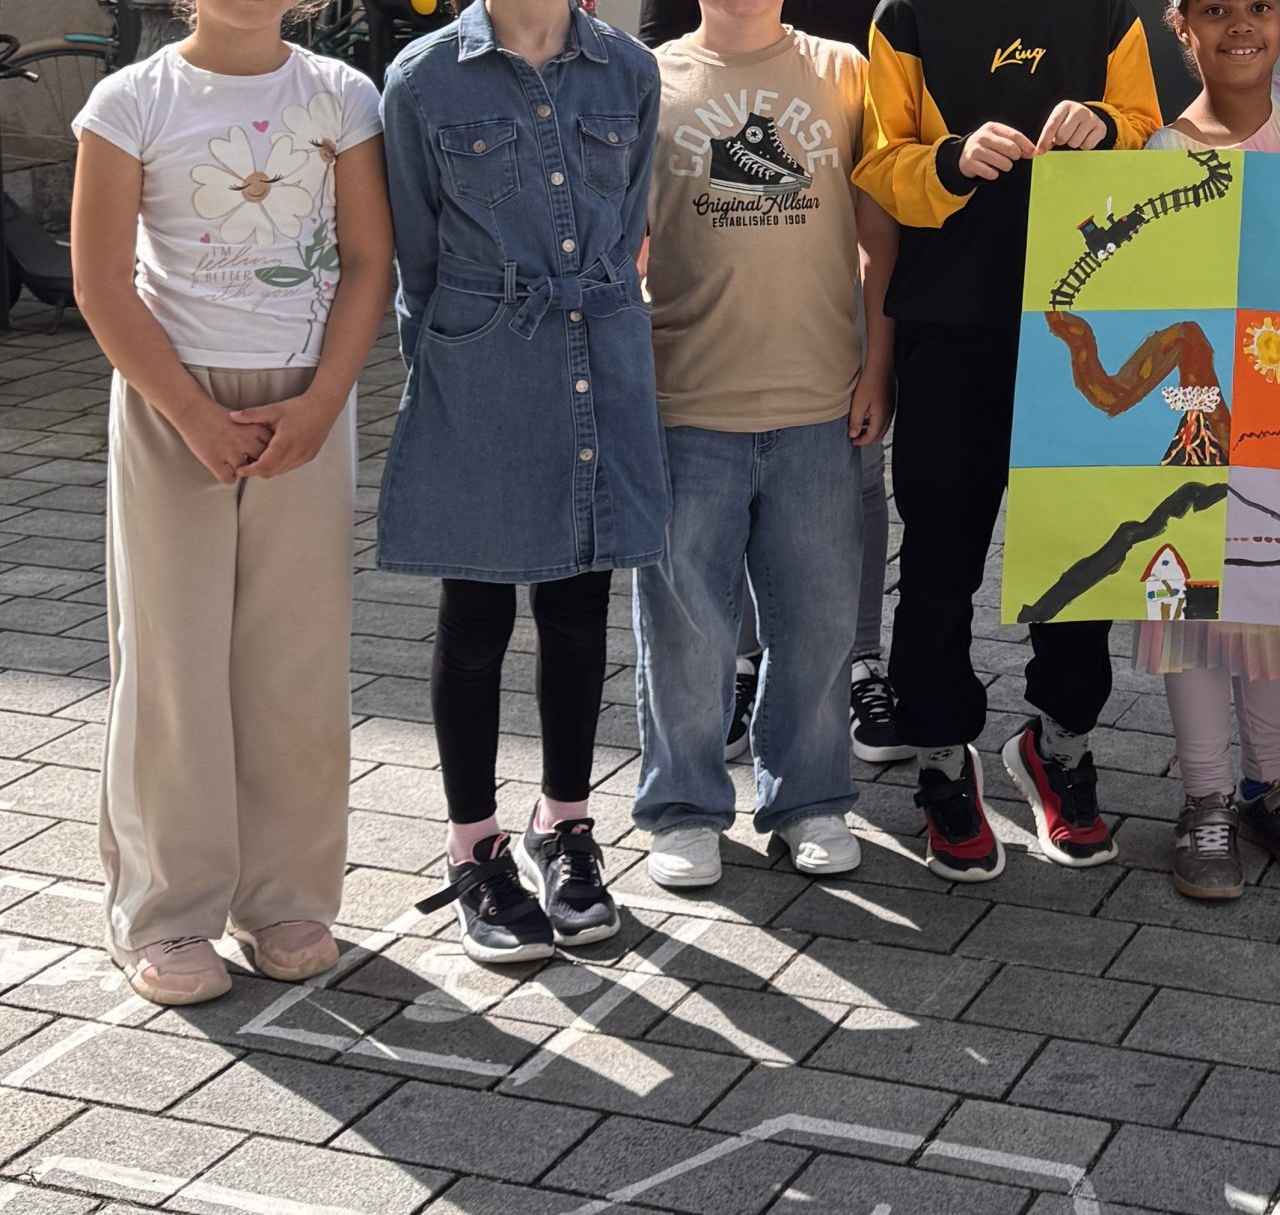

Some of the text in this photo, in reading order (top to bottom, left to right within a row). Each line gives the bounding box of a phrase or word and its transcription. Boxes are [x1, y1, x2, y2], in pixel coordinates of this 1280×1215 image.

[990, 37, 1047, 74] King
[669, 88, 839, 178] CONVERSE
[692, 191, 821, 220] Original Allstar
[712, 214, 779, 228] ESTABLISHED
[205, 270, 253, 282] BETTER
